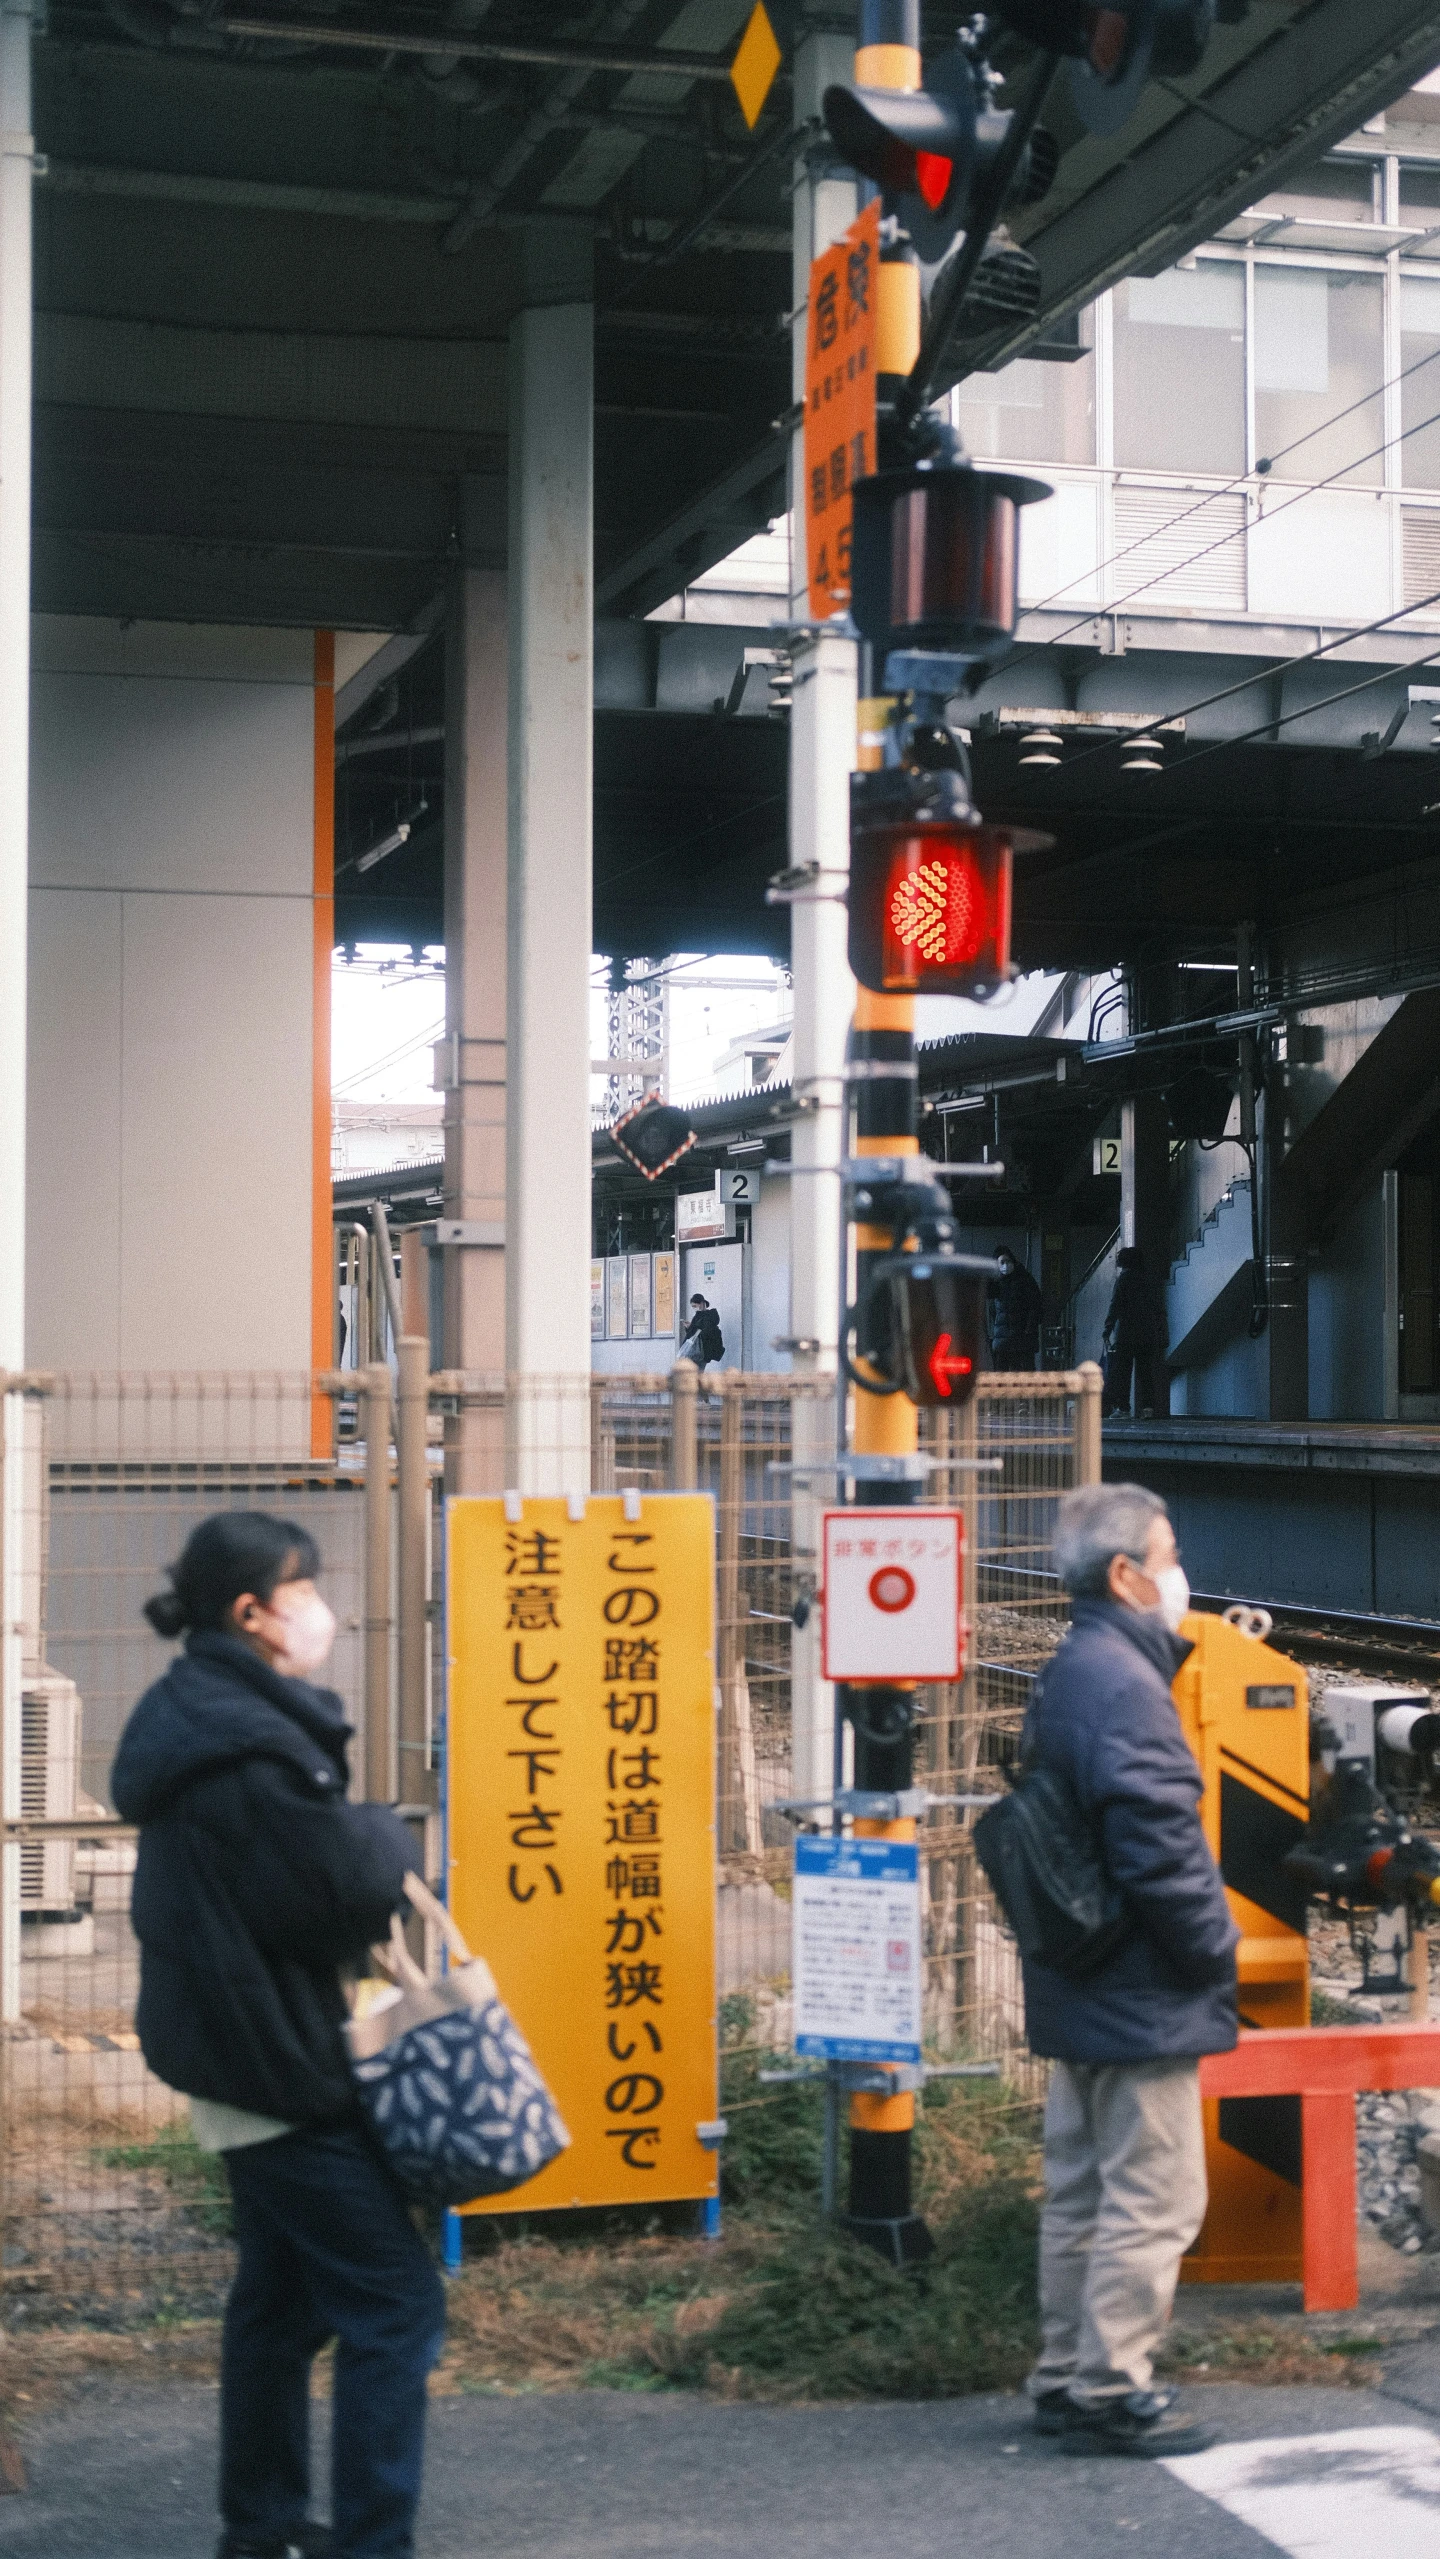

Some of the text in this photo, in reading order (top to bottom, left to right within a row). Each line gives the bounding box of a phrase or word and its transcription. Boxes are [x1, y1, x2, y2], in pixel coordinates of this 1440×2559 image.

[1106, 1143, 1118, 1168] 2
[732, 1174, 749, 1199] 2
[835, 1538, 953, 1560] 非常ボタン
[504, 1531, 563, 1903] 注意して下さい
[604, 1532, 664, 2171] この踏切は道幅が狭いので
